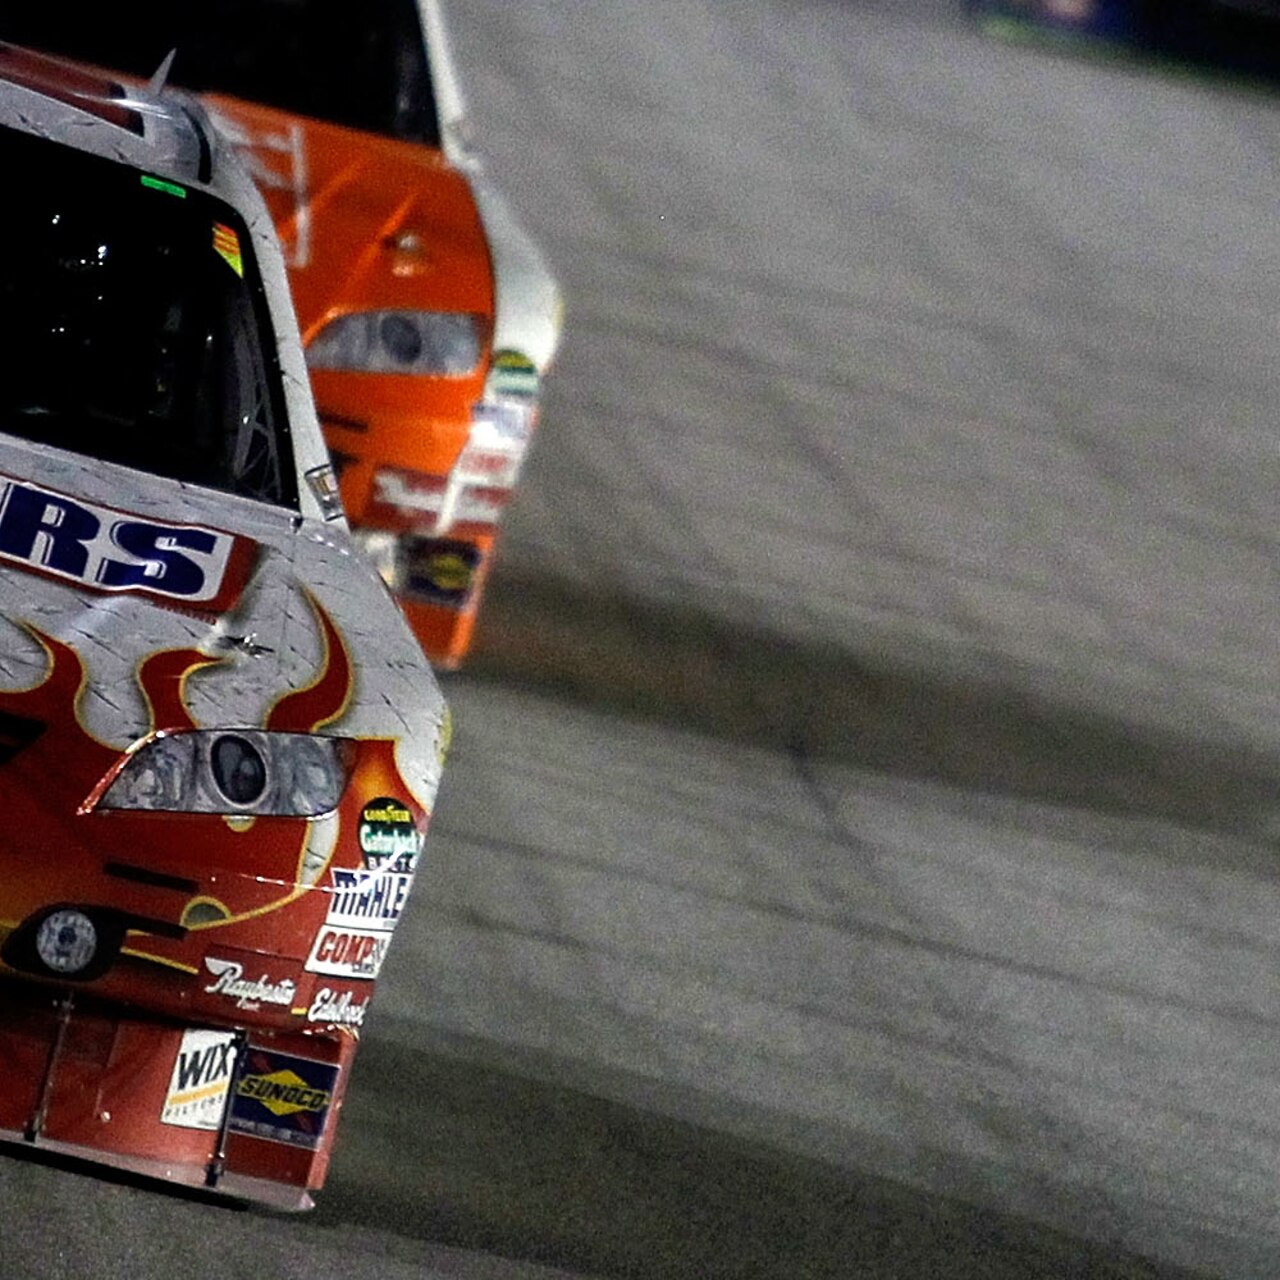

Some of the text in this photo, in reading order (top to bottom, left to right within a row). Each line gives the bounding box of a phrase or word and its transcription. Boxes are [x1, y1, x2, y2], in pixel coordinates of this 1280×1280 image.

[331, 870, 410, 919] MAHLE
[315, 930, 376, 965] COMP
[178, 1043, 232, 1091] WIX
[238, 1075, 332, 1112] SUNOCO
